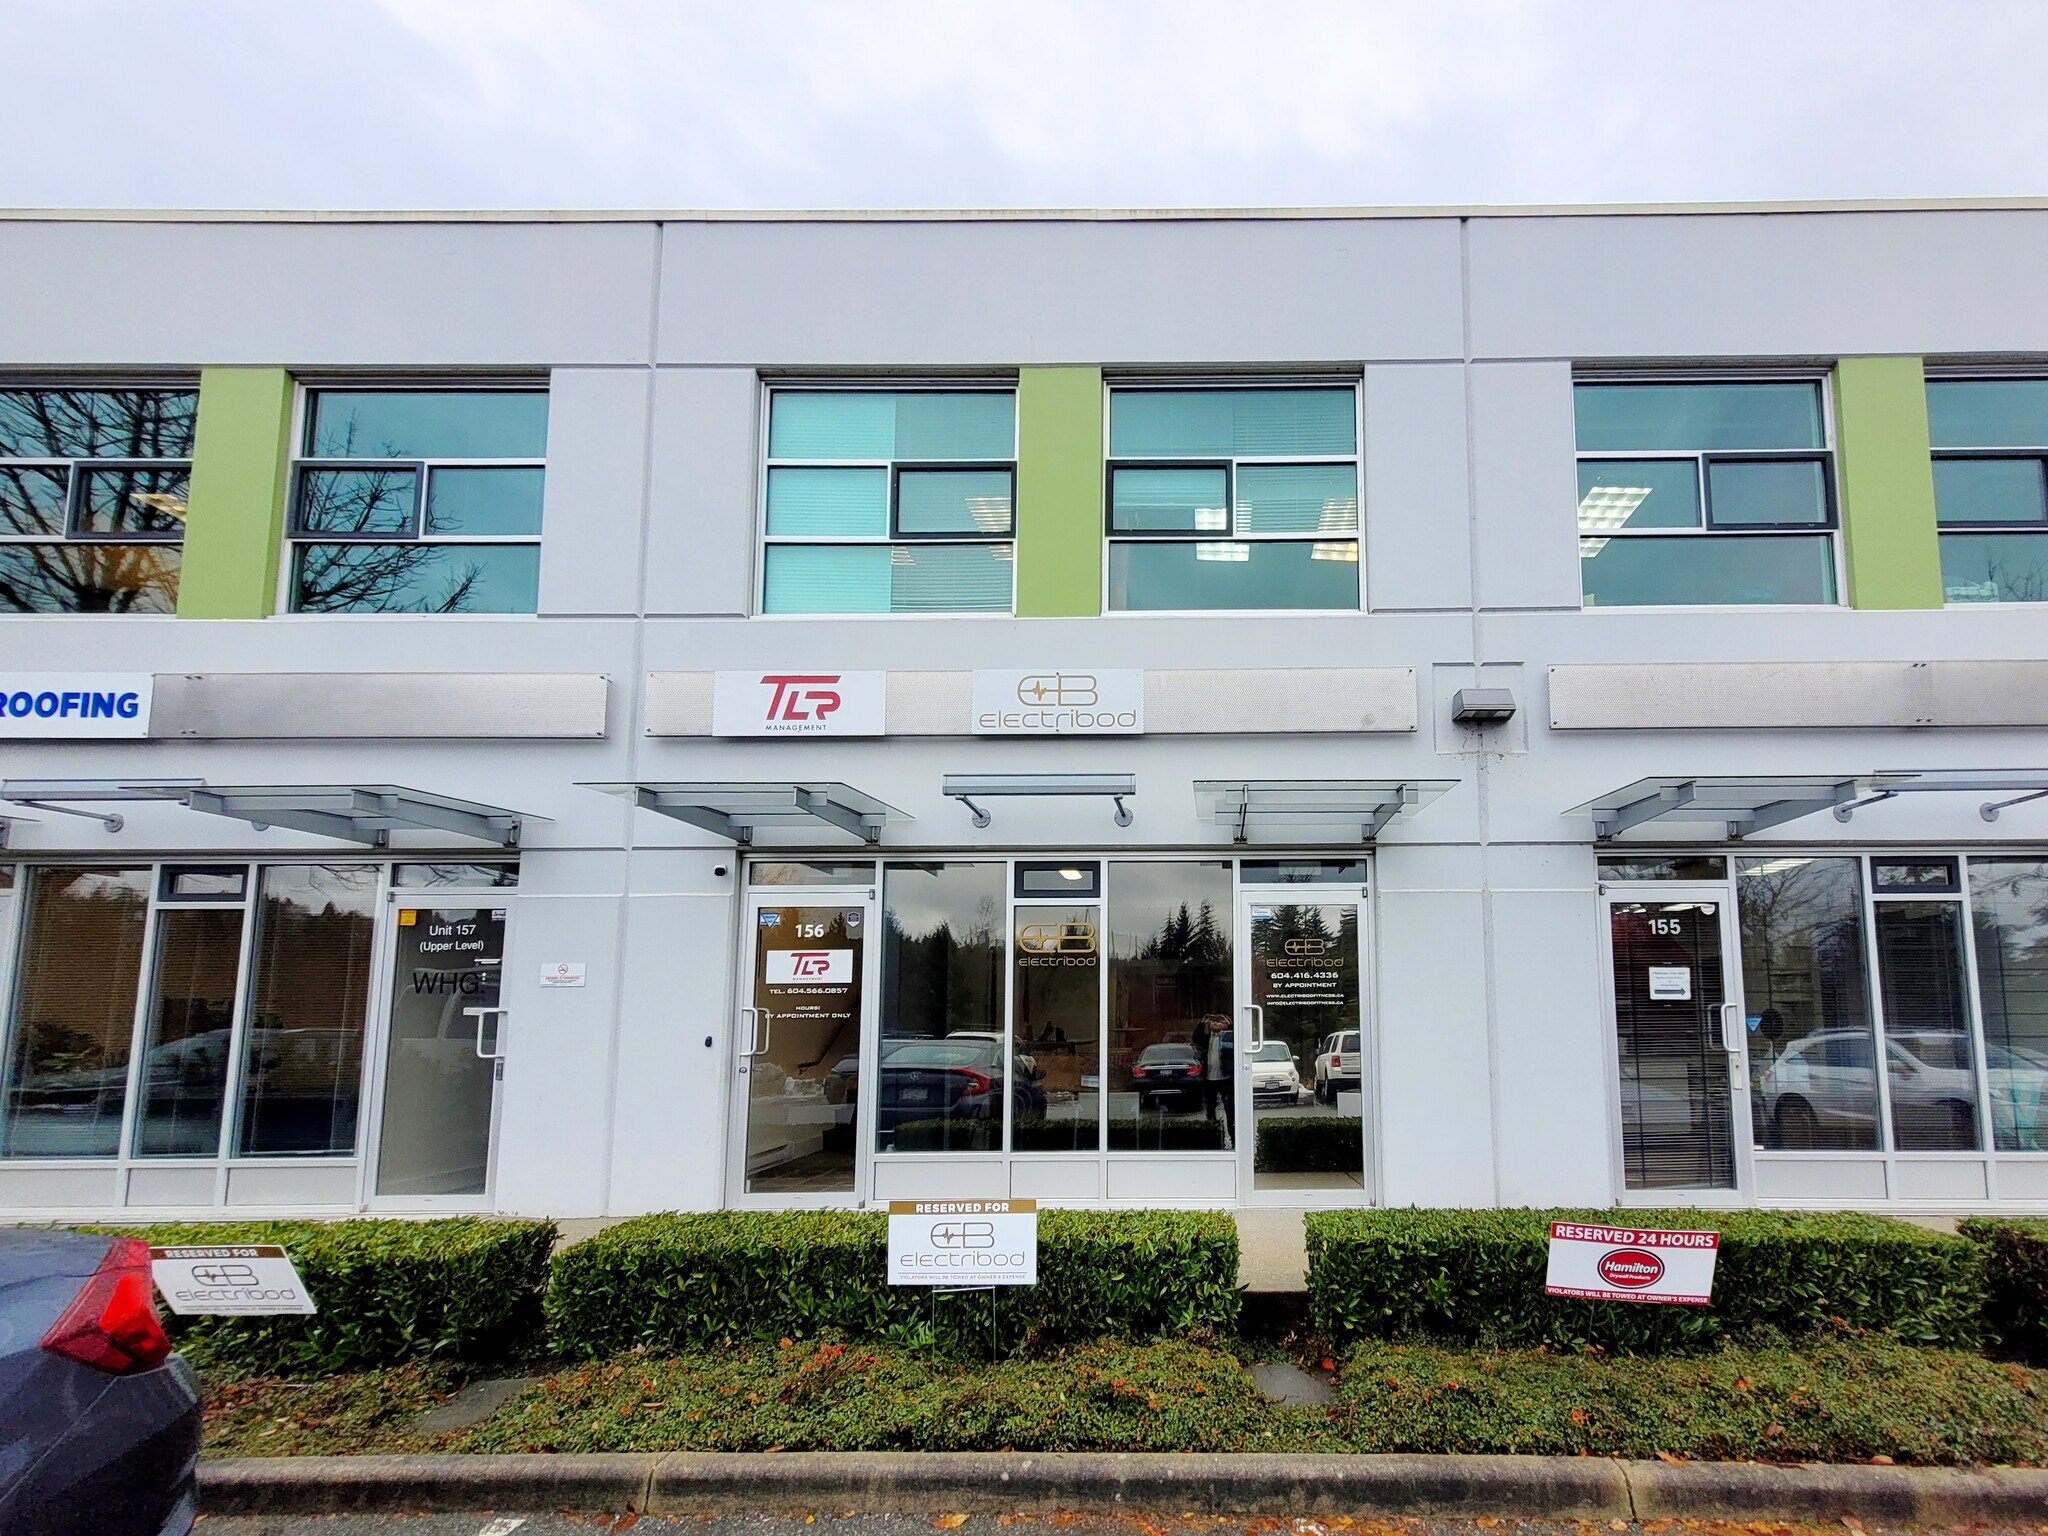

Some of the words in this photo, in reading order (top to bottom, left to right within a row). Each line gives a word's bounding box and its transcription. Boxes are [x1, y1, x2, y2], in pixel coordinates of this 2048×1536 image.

[979, 709, 1136, 728] electribod
[429, 925, 452, 936] Unit
[456, 924, 476, 935] 157
[795, 924, 824, 938] 156
[1648, 919, 1681, 935] 155
[419, 941, 452, 952] (Upper
[455, 940, 484, 951] Level)
[1018, 956, 1096, 966] electribod
[1266, 957, 1344, 967] electribod
[915, 1203, 982, 1213] RESERVED
[985, 1202, 1010, 1212] FOR
[1555, 1225, 1635, 1243] RESERVED
[1637, 1232, 1657, 1245] 24
[1660, 1233, 1714, 1247] HOURS
[165, 1249, 231, 1259] RESERVED
[233, 1248, 259, 1257] FOR
[900, 1250, 1025, 1267] electribod
[1604, 1260, 1658, 1274] Hamilton
[175, 1287, 296, 1301] electribod
[1547, 1287, 1585, 1296] VIOLATORS
[1585, 1290, 1601, 1298] WILL
[1612, 1292, 1637, 1300] TOWED
